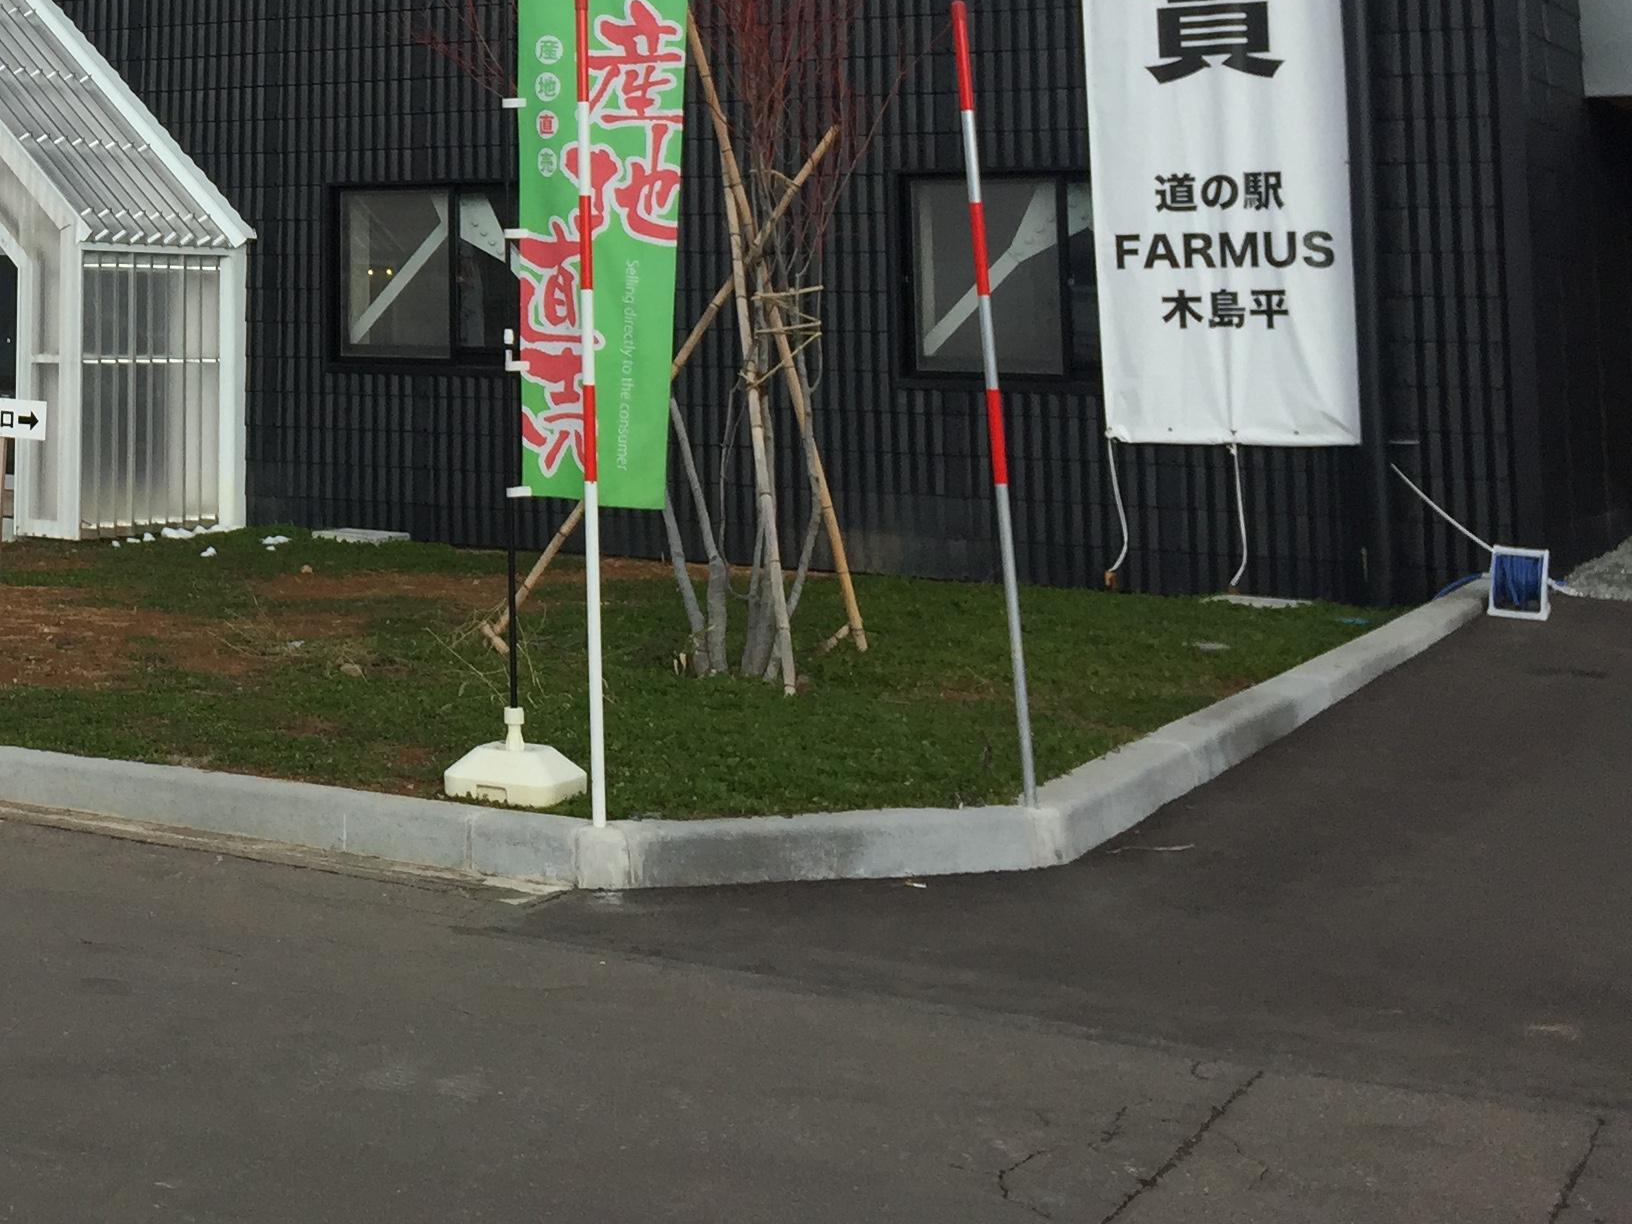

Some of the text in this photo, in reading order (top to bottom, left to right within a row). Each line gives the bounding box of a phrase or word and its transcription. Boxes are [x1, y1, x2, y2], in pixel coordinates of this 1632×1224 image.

[1155, 171, 1284, 212] 道の駅
[1115, 231, 1335, 269] FARMUS
[1162, 290, 1289, 329] 木島平
[616, 260, 639, 472] Selling directly to the consumer
